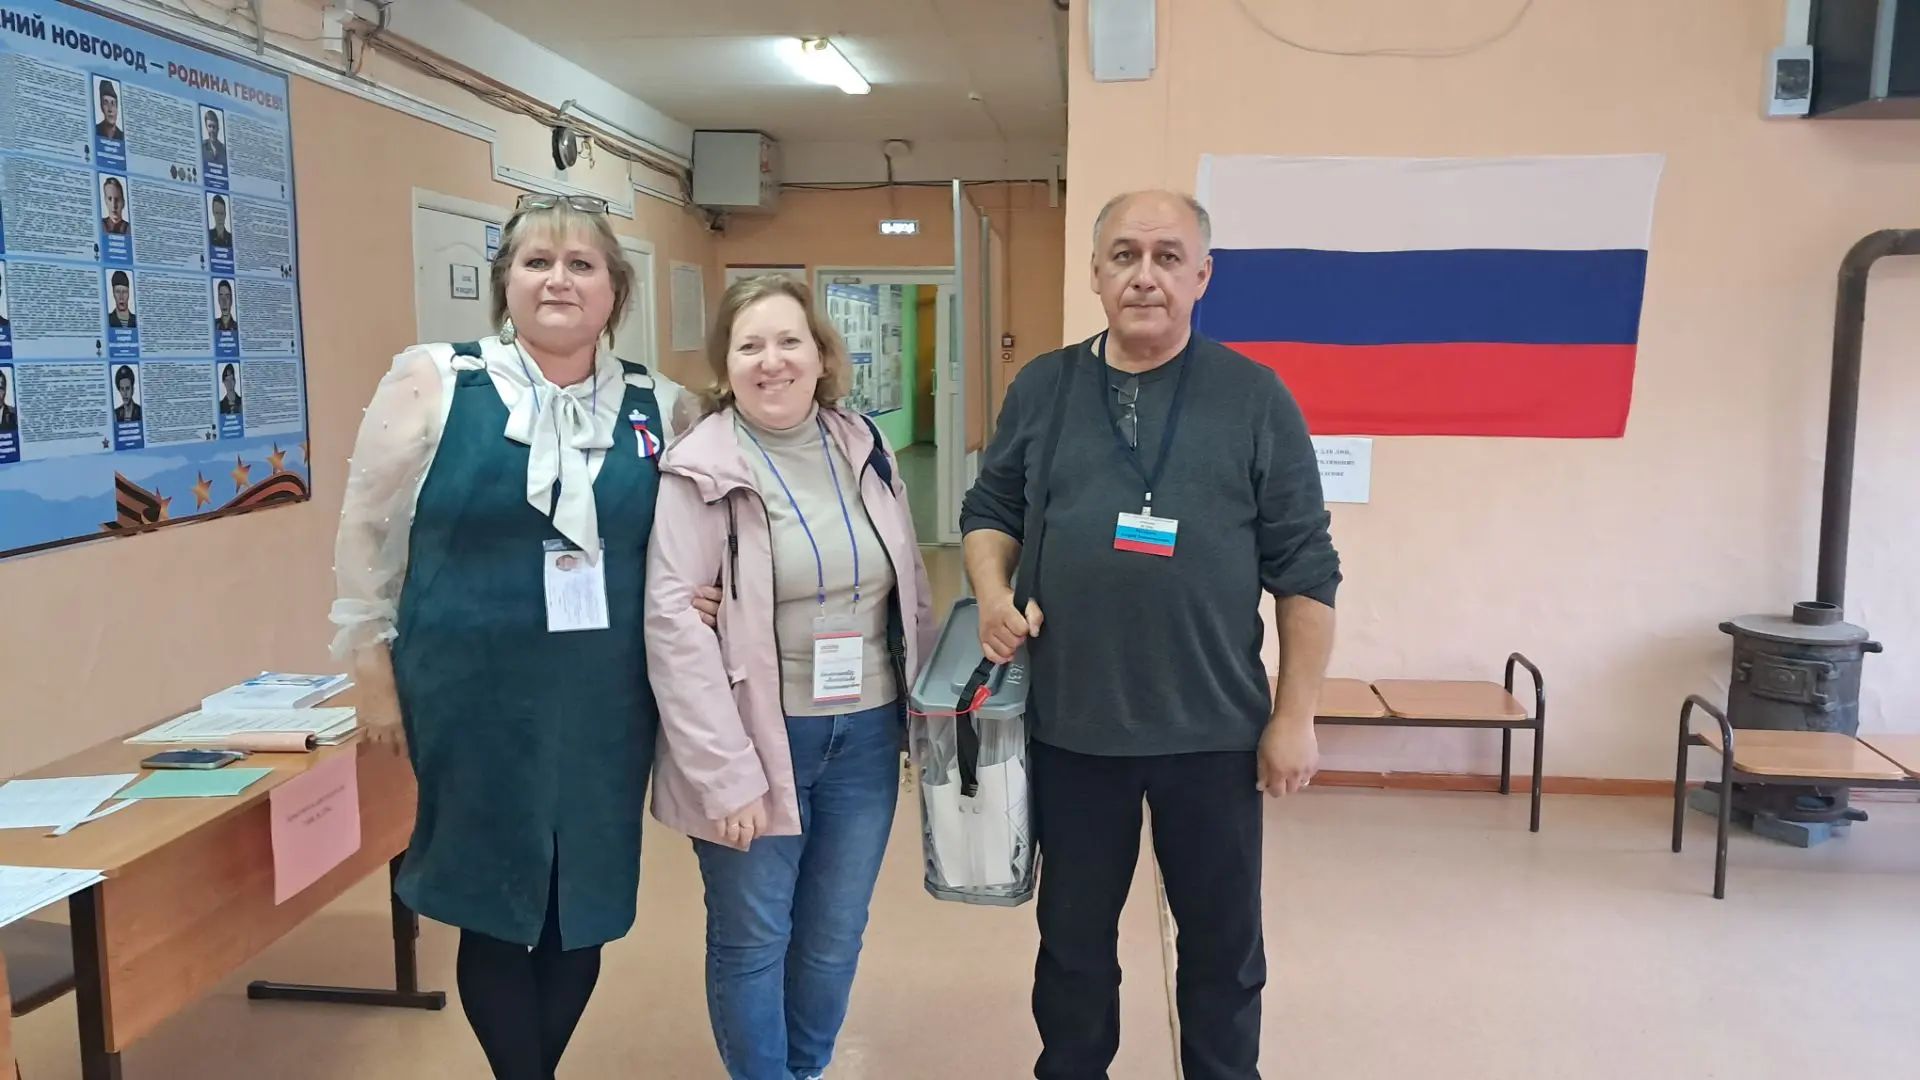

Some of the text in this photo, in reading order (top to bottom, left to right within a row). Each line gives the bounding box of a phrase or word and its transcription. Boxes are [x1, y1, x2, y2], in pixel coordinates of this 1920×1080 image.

[0, 8, 46, 40] НИЙ
[52, 24, 147, 73] НОВГОРОД
[168, 61, 230, 96] РОДИНА
[1006, 664, 1024, 684] 2631
